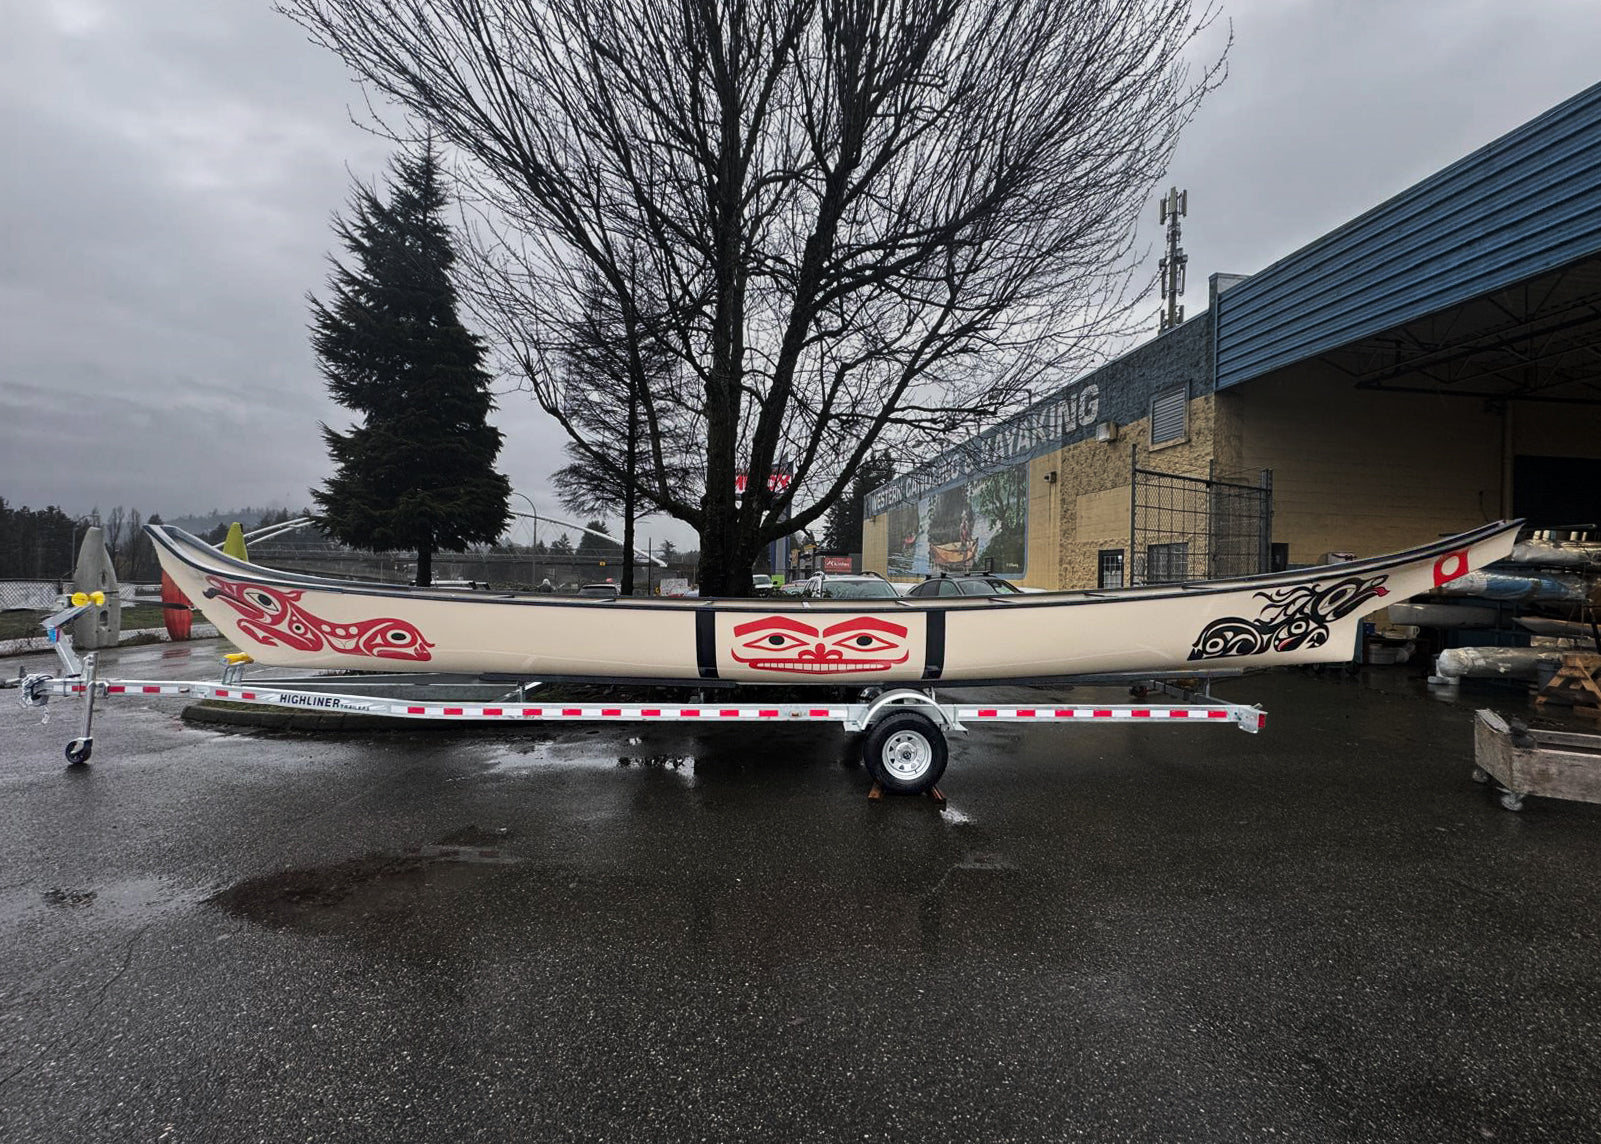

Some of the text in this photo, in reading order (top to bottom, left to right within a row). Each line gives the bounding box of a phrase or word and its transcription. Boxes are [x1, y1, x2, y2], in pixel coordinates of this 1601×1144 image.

[872, 484, 902, 511] WESTERN
[981, 384, 1099, 467] KAYAKING
[280, 694, 340, 708] HIGHLINER
